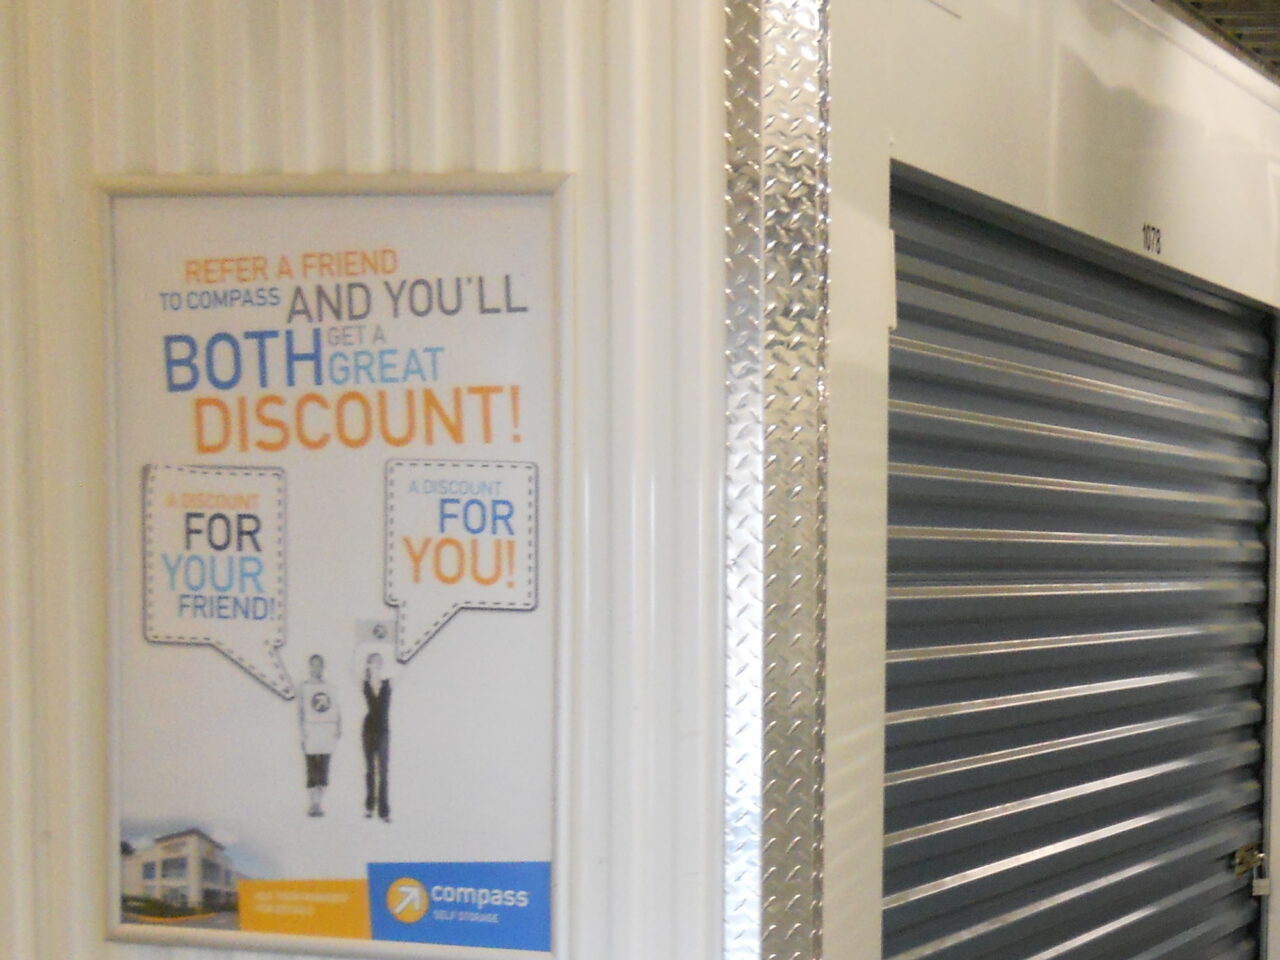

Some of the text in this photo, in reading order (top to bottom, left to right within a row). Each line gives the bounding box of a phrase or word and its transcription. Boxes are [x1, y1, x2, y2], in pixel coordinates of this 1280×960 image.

[184, 249, 398, 284] REFER A FRIEND
[159, 286, 281, 311] TO COMPASS
[287, 274, 529, 324] AND YOU'LL
[327, 325, 388, 347] GET A
[163, 327, 324, 393] BOTH
[328, 347, 445, 386] GREAT
[193, 384, 522, 455] DISCOUNT!
[408, 479, 503, 496] A DISCOUNT
[184, 512, 263, 552] FOR
[438, 498, 515, 536] FOR
[161, 553, 265, 593] YOUR
[402, 536, 517, 590] YOU!
[431, 885, 530, 910] compass
